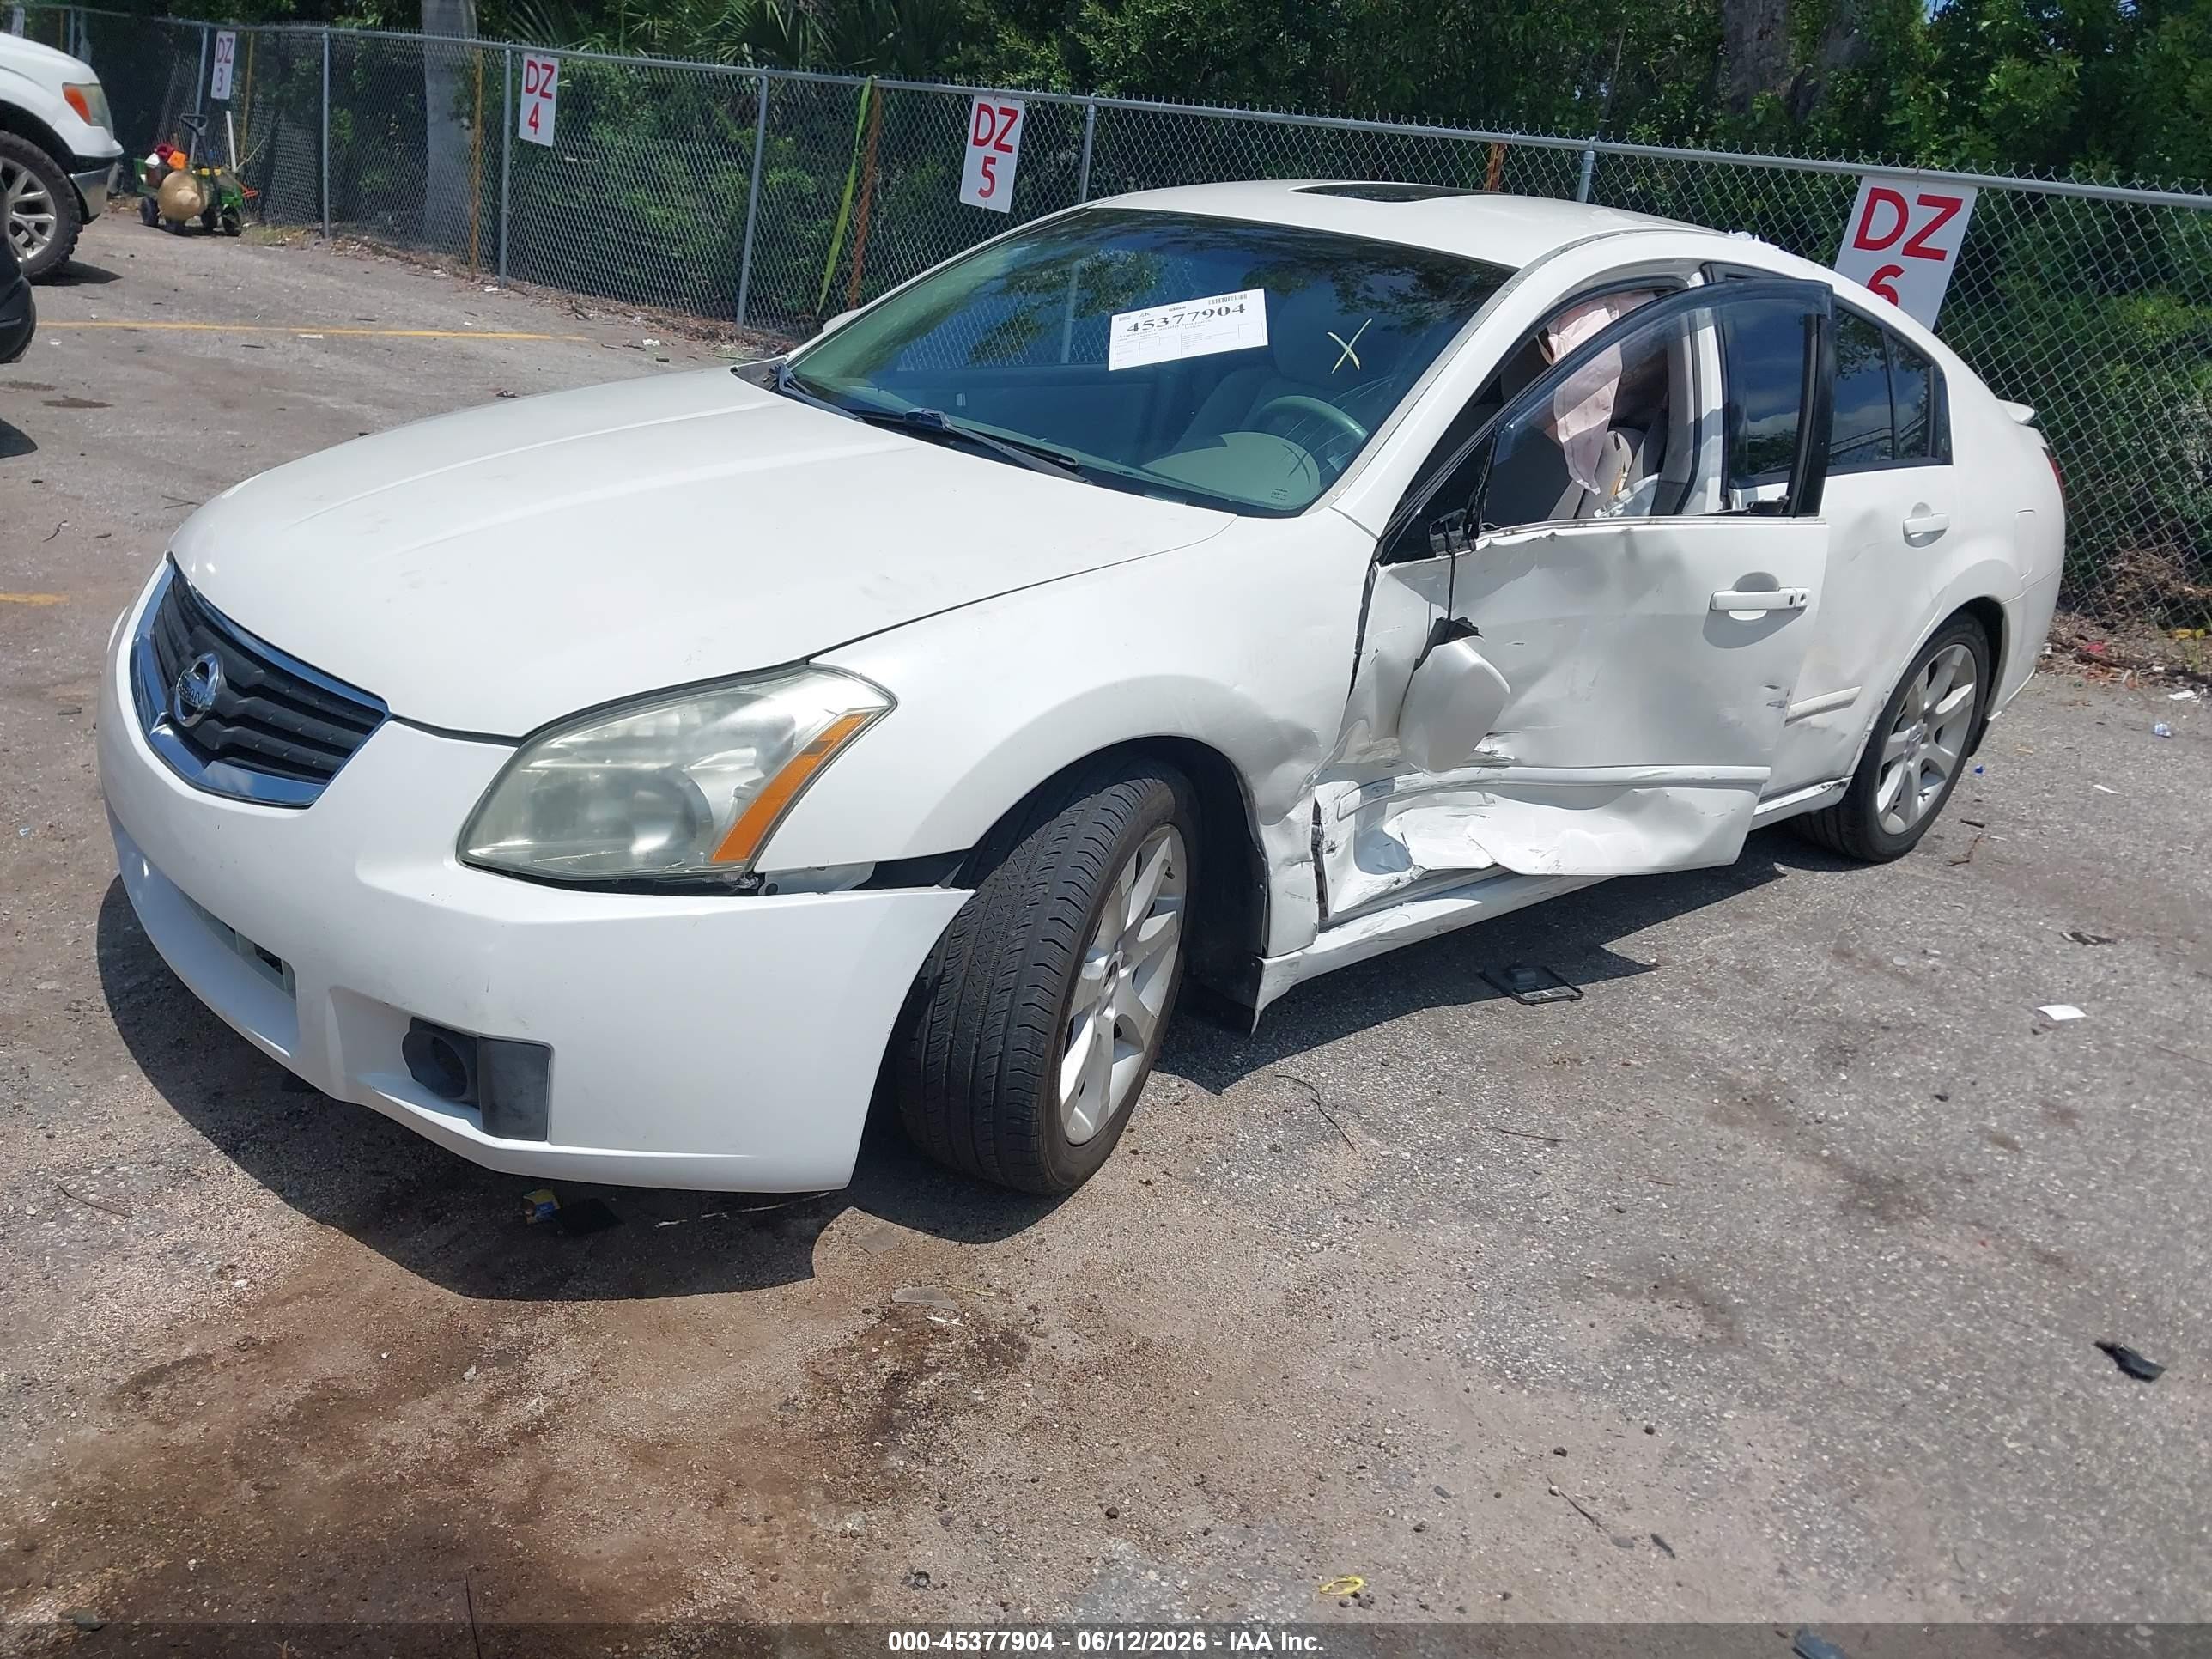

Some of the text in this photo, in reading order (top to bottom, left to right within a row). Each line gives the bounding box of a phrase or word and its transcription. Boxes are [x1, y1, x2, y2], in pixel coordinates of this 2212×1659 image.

[216, 37, 234, 64] DZ
[216, 68, 224, 92] 3
[526, 59, 555, 100] DZ
[528, 102, 539, 135] 4
[973, 103, 1018, 153] DZ
[978, 155, 996, 198] 5
[1852, 187, 1964, 261] DZ
[1866, 264, 1905, 307] 6
[1127, 303, 1246, 332] 45377904
